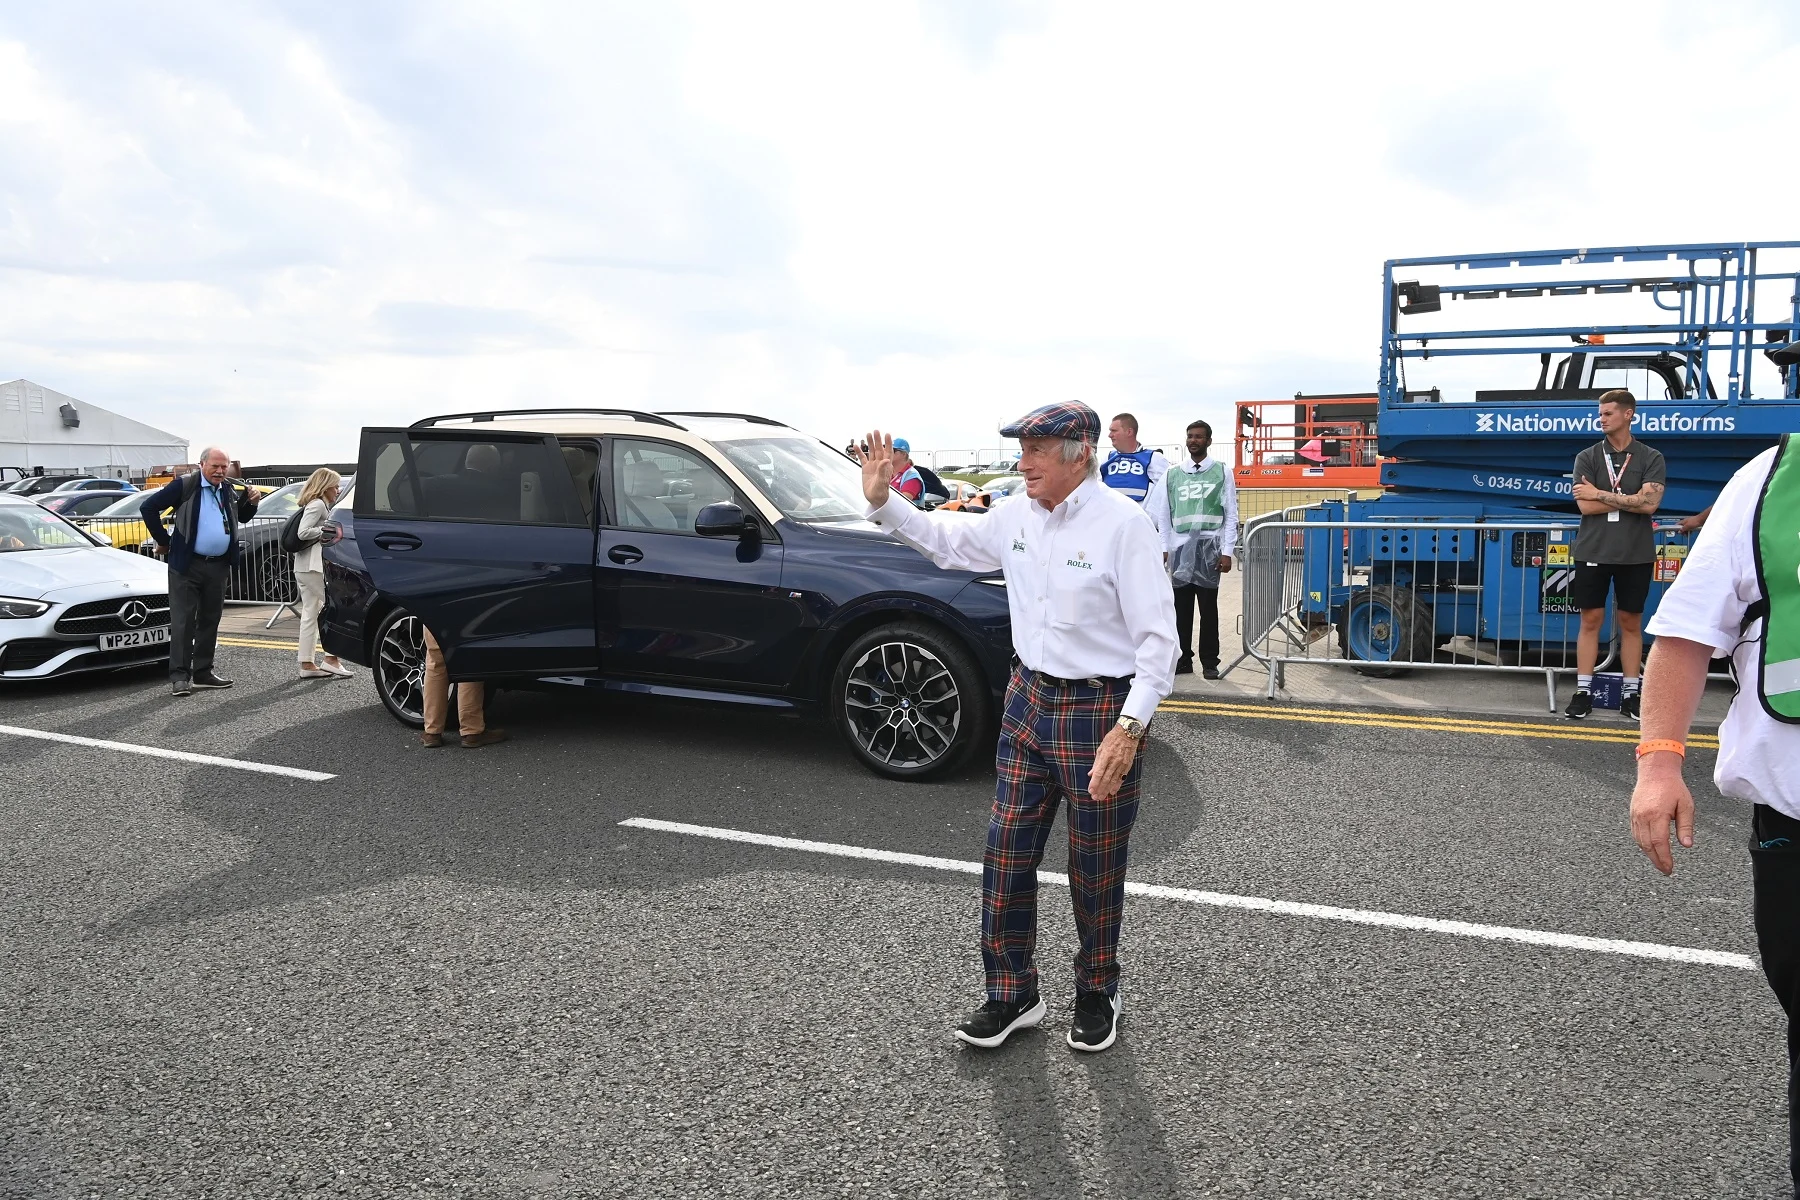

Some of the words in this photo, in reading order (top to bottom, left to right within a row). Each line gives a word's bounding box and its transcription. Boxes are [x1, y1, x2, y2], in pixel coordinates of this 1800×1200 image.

[1497, 413, 1602, 432] Nationwi
[1629, 412, 1735, 432] Platforms
[1107, 461, 1144, 475] 098
[1177, 483, 1216, 501] 327
[1488, 476, 1521, 489] 0345
[1526, 479, 1551, 493] 745
[1555, 482, 1572, 494] 00
[1067, 559, 1092, 570] ROLEX
[1541, 596, 1574, 604] SPORT
[1541, 604, 1582, 613] SIGNAG
[106, 633, 139, 648] WP22
[143, 629, 164, 643] AYD
